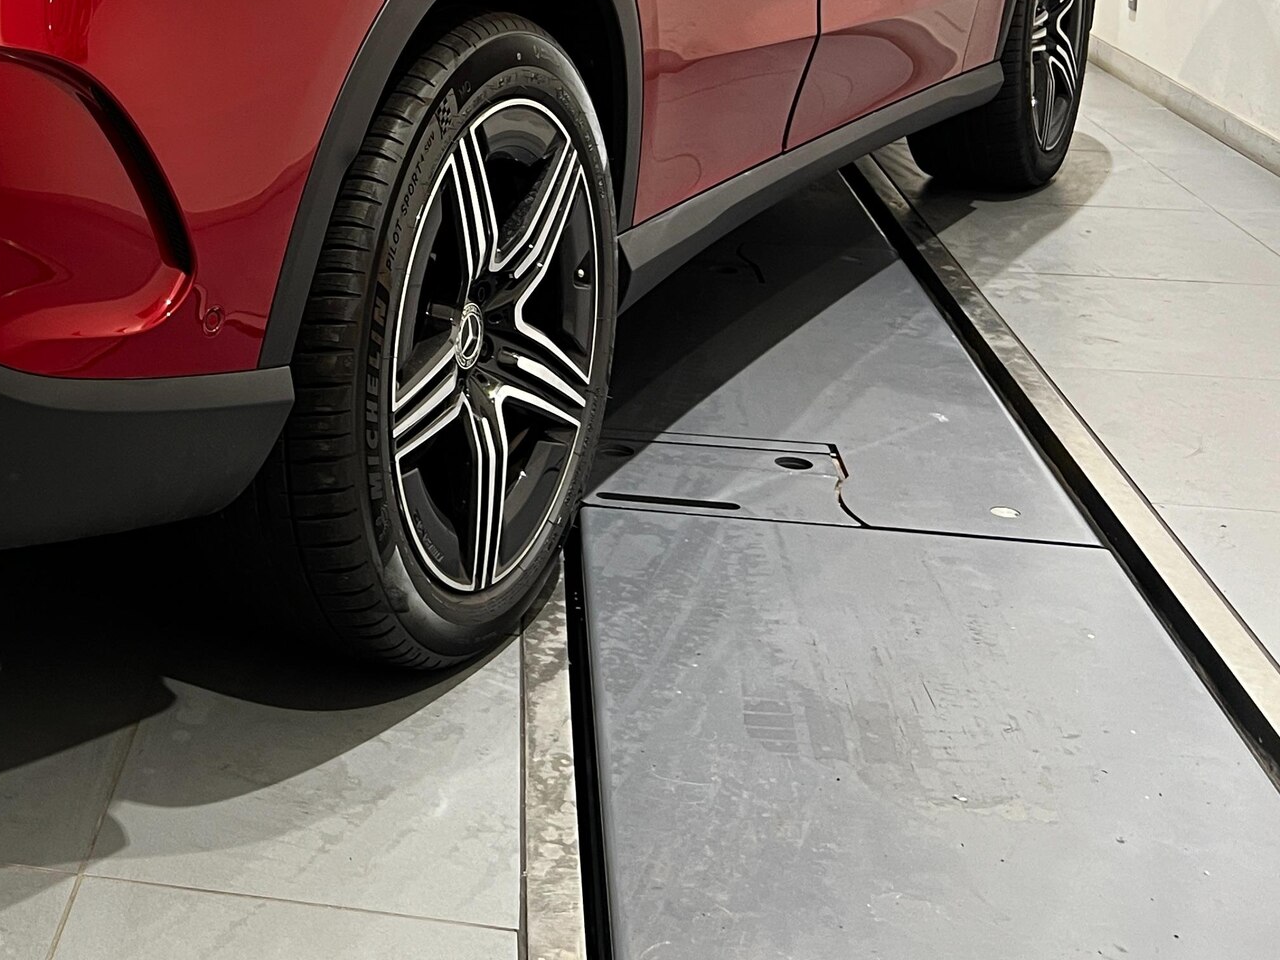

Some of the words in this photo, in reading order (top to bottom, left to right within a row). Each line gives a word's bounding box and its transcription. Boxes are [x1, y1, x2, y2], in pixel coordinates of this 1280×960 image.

[385, 219, 403, 272] PILOT
[401, 163, 423, 216] SPORT
[424, 130, 436, 154] SUV
[365, 299, 388, 501] MICHELIN
